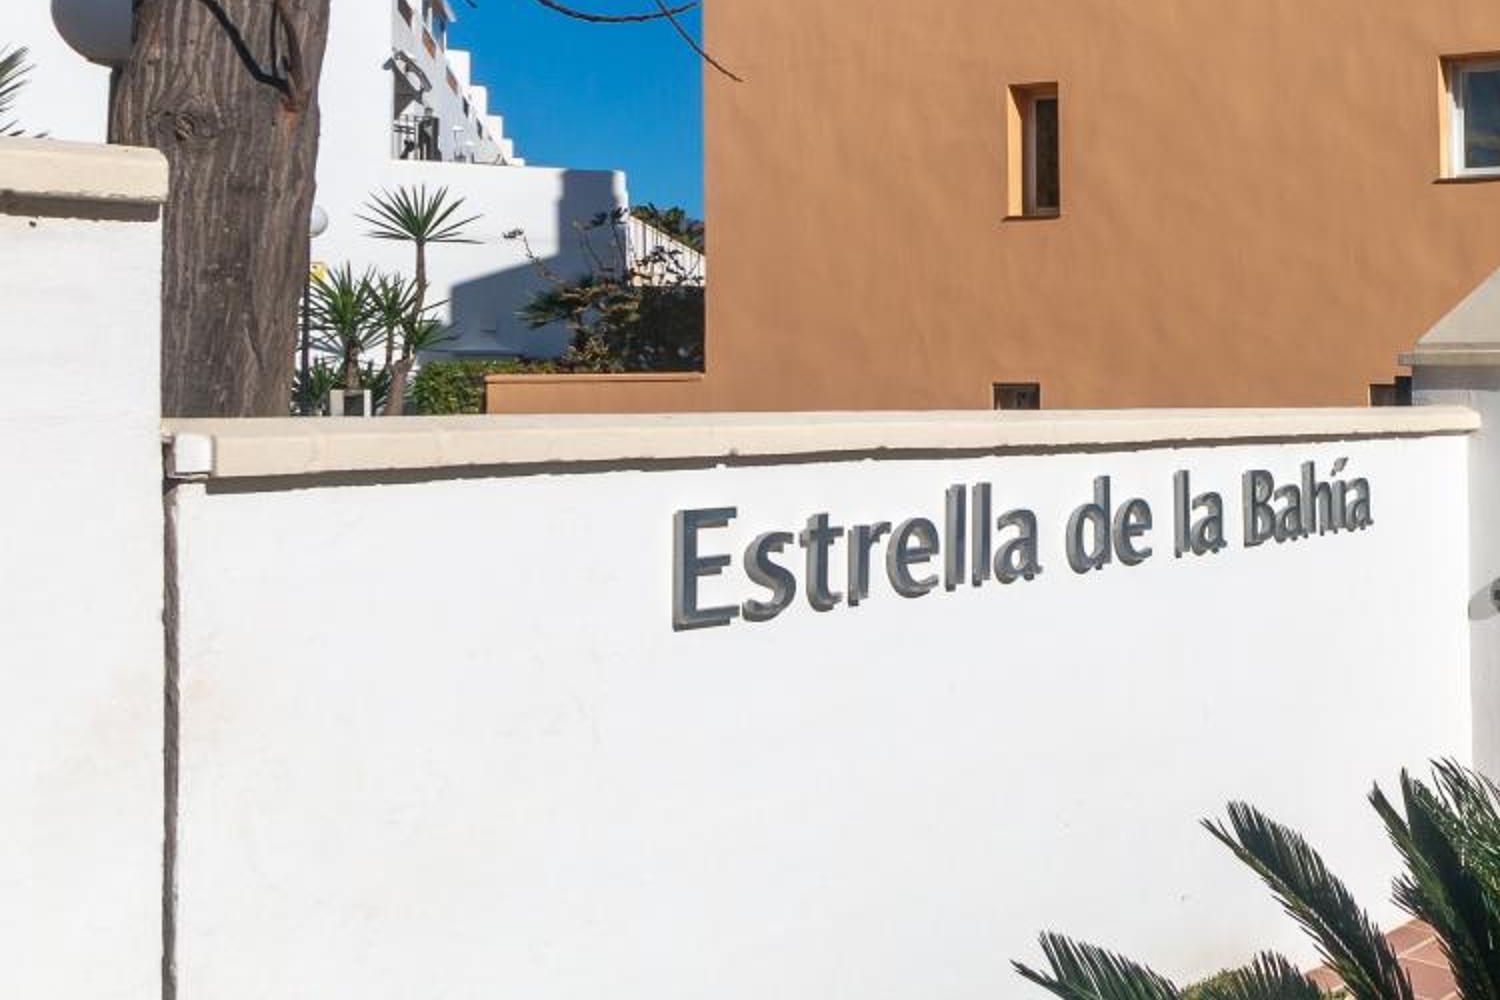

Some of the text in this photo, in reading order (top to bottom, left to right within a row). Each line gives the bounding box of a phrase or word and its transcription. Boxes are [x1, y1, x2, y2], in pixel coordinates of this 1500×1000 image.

[672, 458, 1374, 632] Estrella de la Bahía
